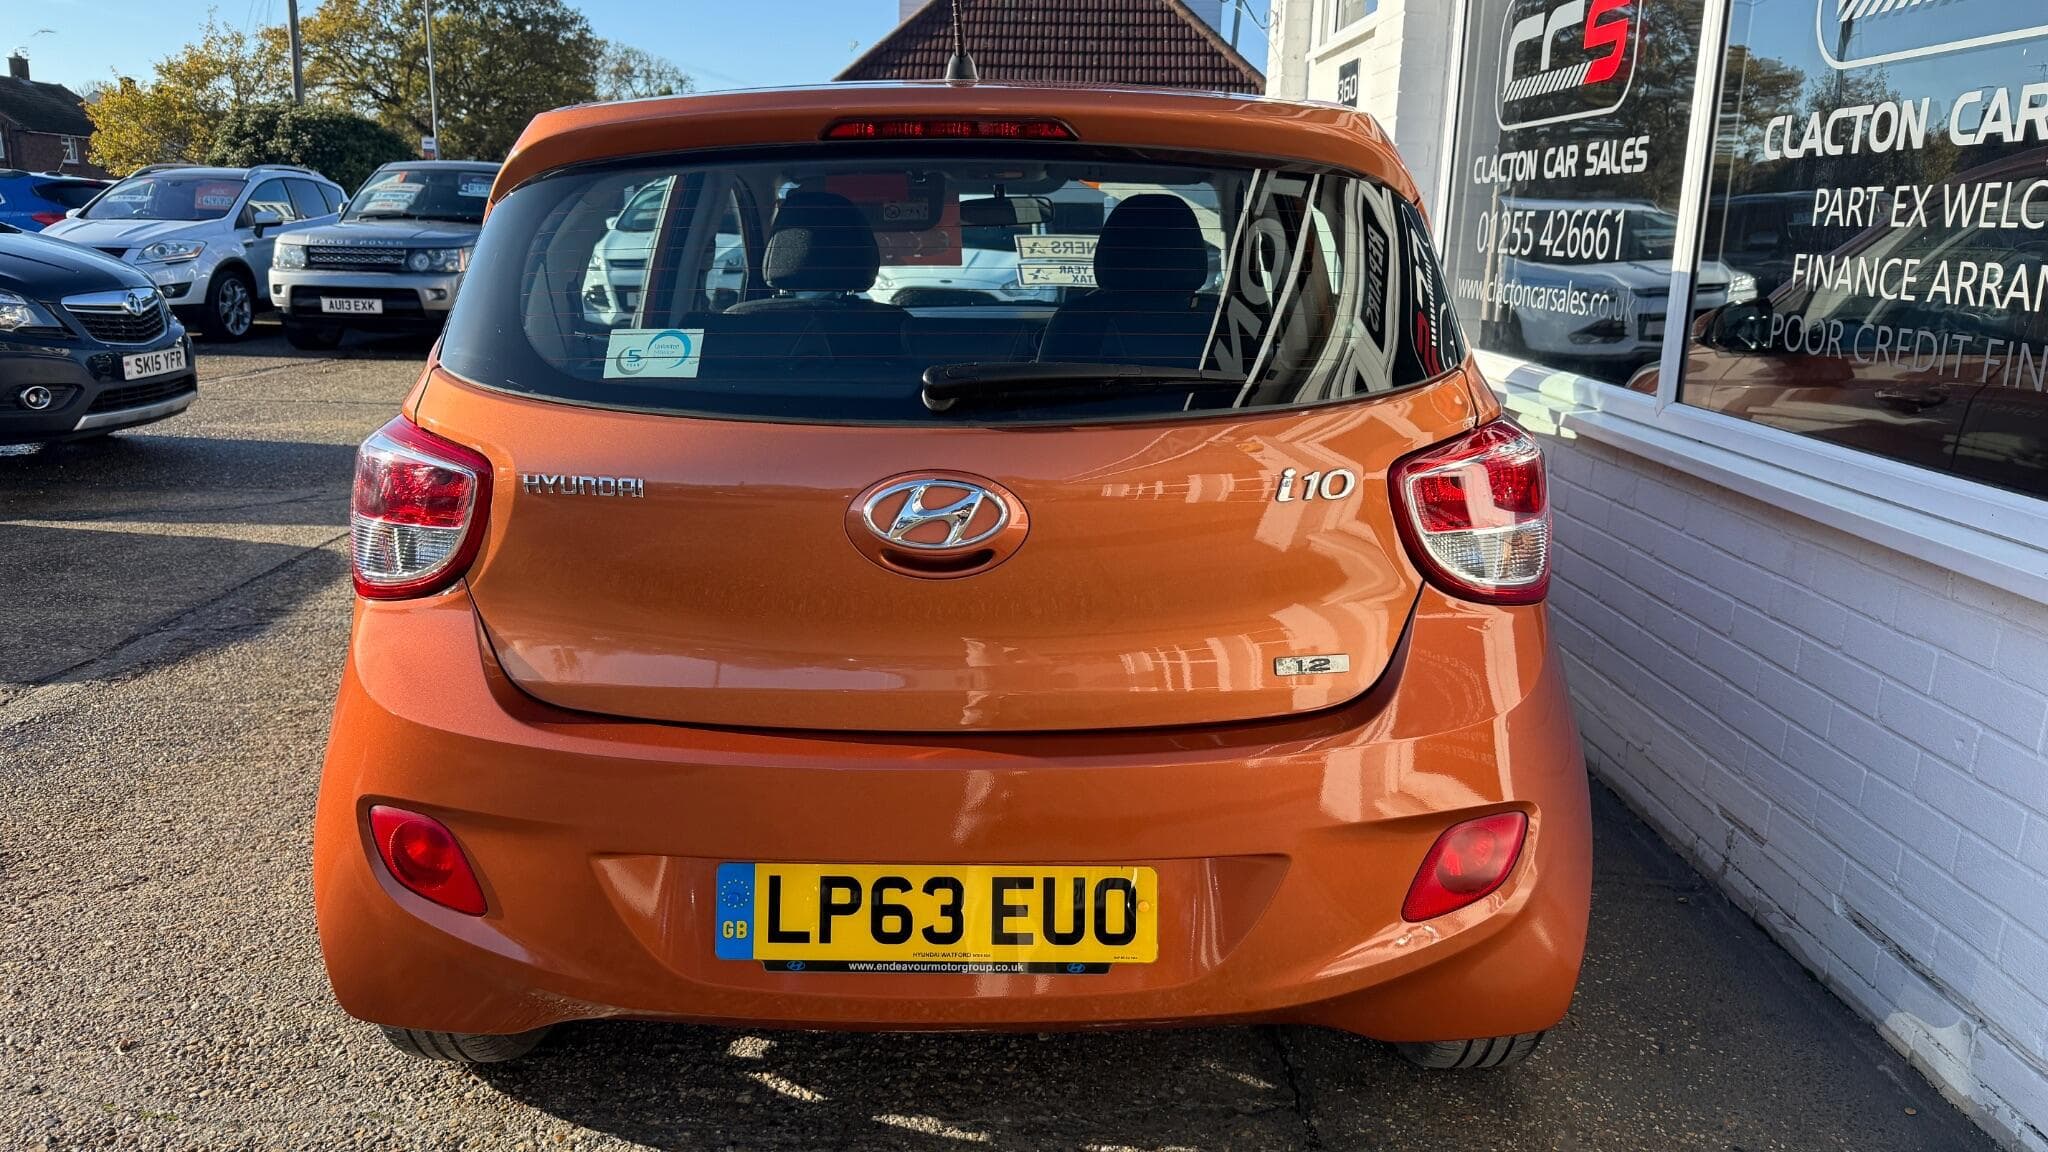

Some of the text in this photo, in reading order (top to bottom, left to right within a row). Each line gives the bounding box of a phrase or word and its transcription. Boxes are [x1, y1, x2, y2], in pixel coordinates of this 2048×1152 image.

[1338, 74, 1357, 104] 360
[1764, 97, 1930, 161] CLACTON
[1474, 136, 1649, 184] CLACTON CAR SALES
[1812, 186, 1884, 227] PART
[1890, 184, 1933, 228] EX
[1476, 208, 1626, 260] 01255 426661
[1791, 253, 1921, 301] FINANCE
[329, 299, 375, 311] AU13 EXK
[1458, 273, 1635, 324] www.clactoncarsales.co.uk
[135, 350, 182, 374] SK15 YFR
[627, 349, 642, 363] 5
[1769, 313, 1844, 359] POOR
[1853, 323, 1973, 378] CREDIT
[523, 473, 645, 498] HYUNDAI
[1276, 467, 1356, 502] i10
[722, 920, 748, 939] GB
[767, 875, 1137, 946] LP63 EUO
[848, 962, 1024, 974] www.endeavourmotorgroup.co.uk
